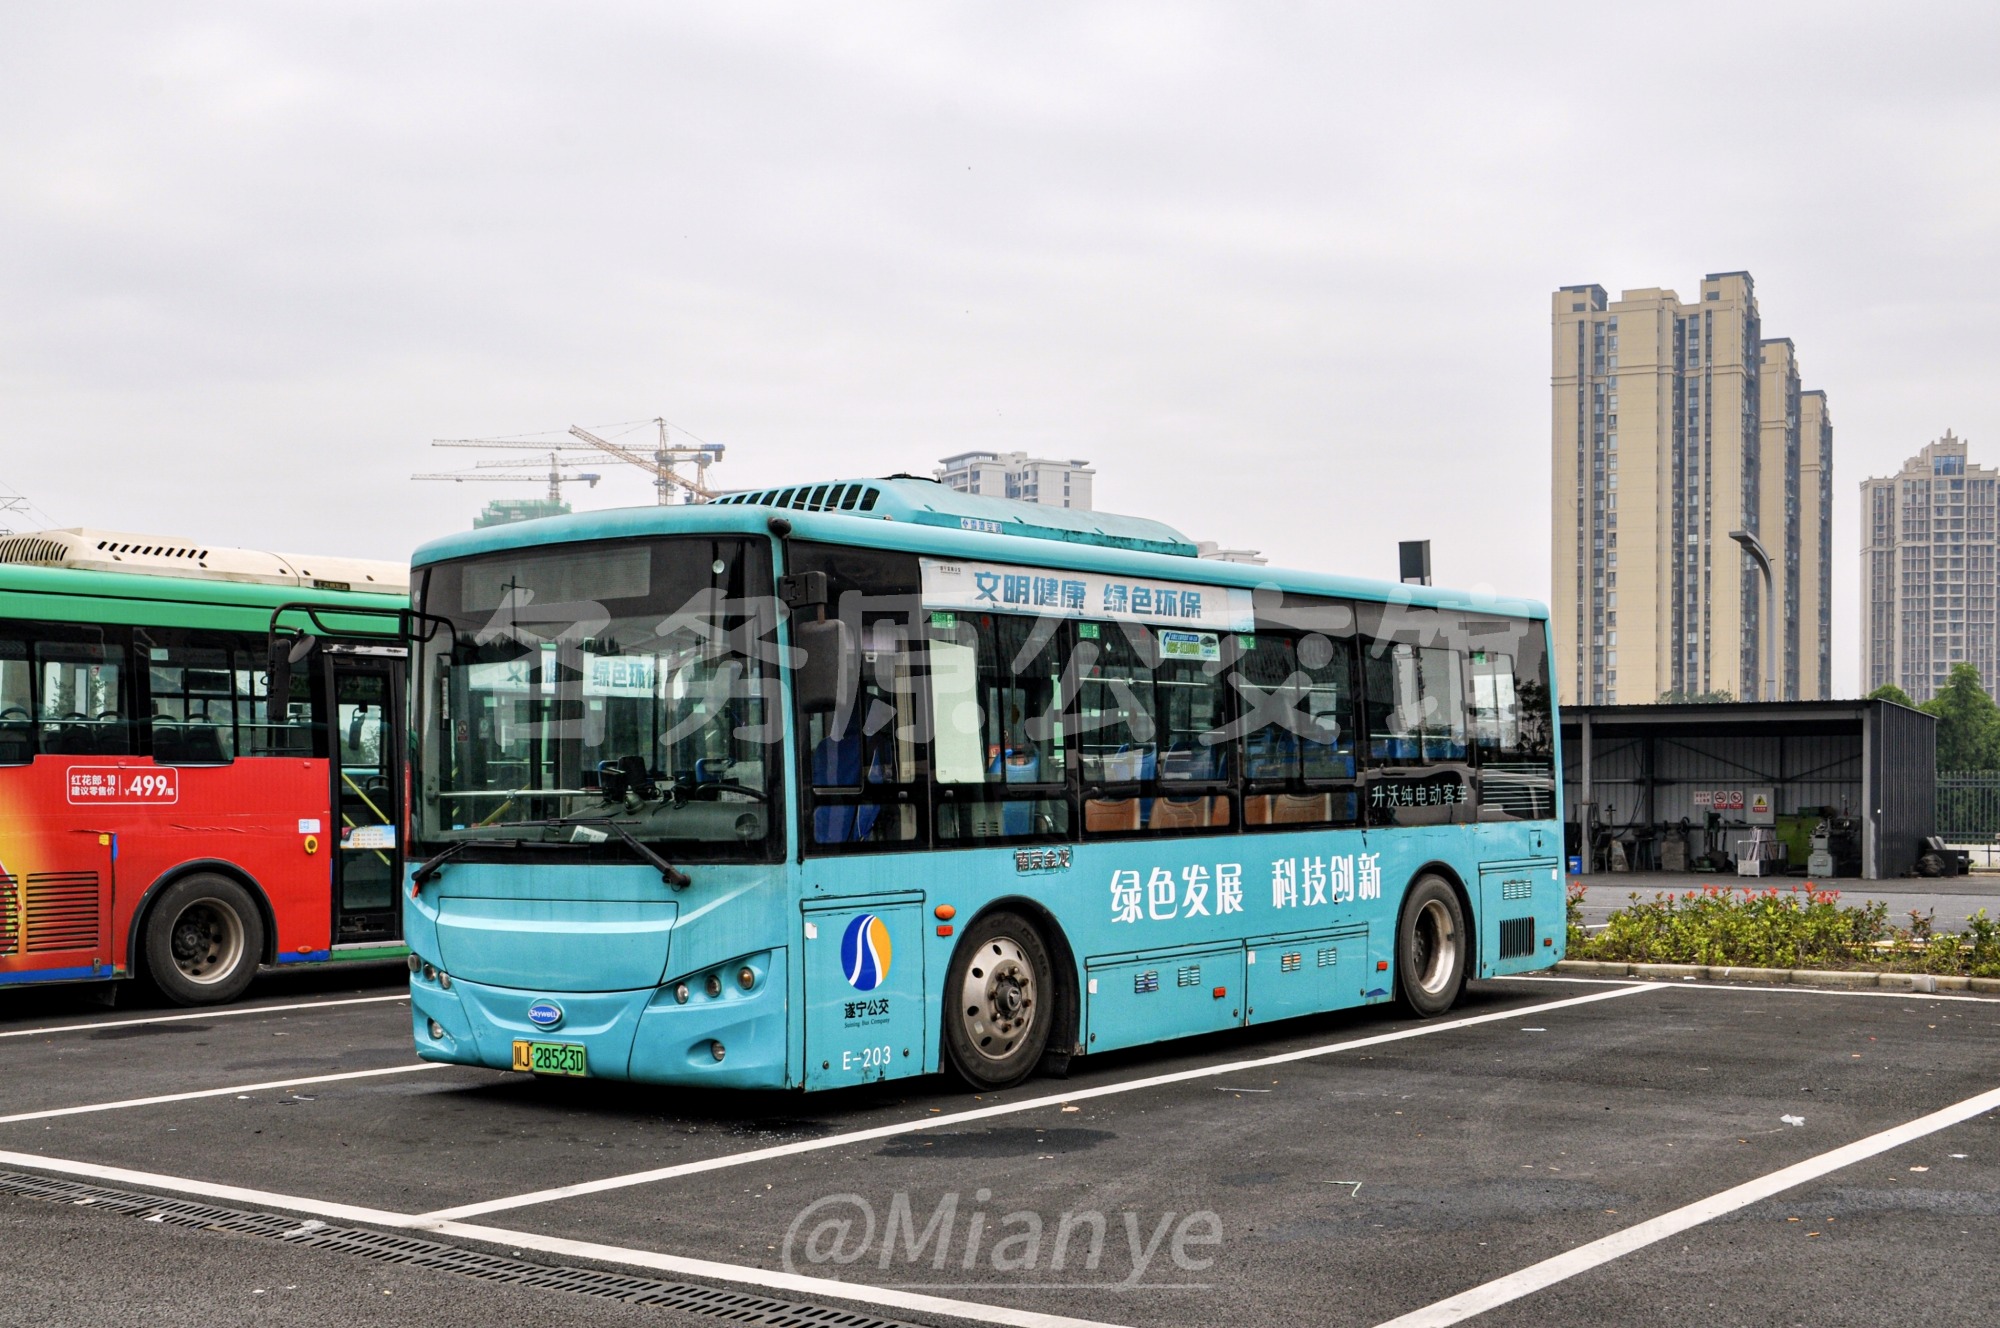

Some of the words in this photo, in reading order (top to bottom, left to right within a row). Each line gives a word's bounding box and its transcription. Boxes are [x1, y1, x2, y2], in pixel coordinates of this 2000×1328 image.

[974, 572, 1087, 609] 文明健康
[1103, 583, 1201, 619] 绿色环保
[71, 786, 116, 796] 建议零售价
[1016, 849, 1071, 872] 南京金龙
[1111, 863, 1244, 923] 绿色发展
[1271, 852, 1382, 909] 科技创新
[844, 998, 889, 1019] 遂宁公交
[843, 1045, 891, 1071] E-203
